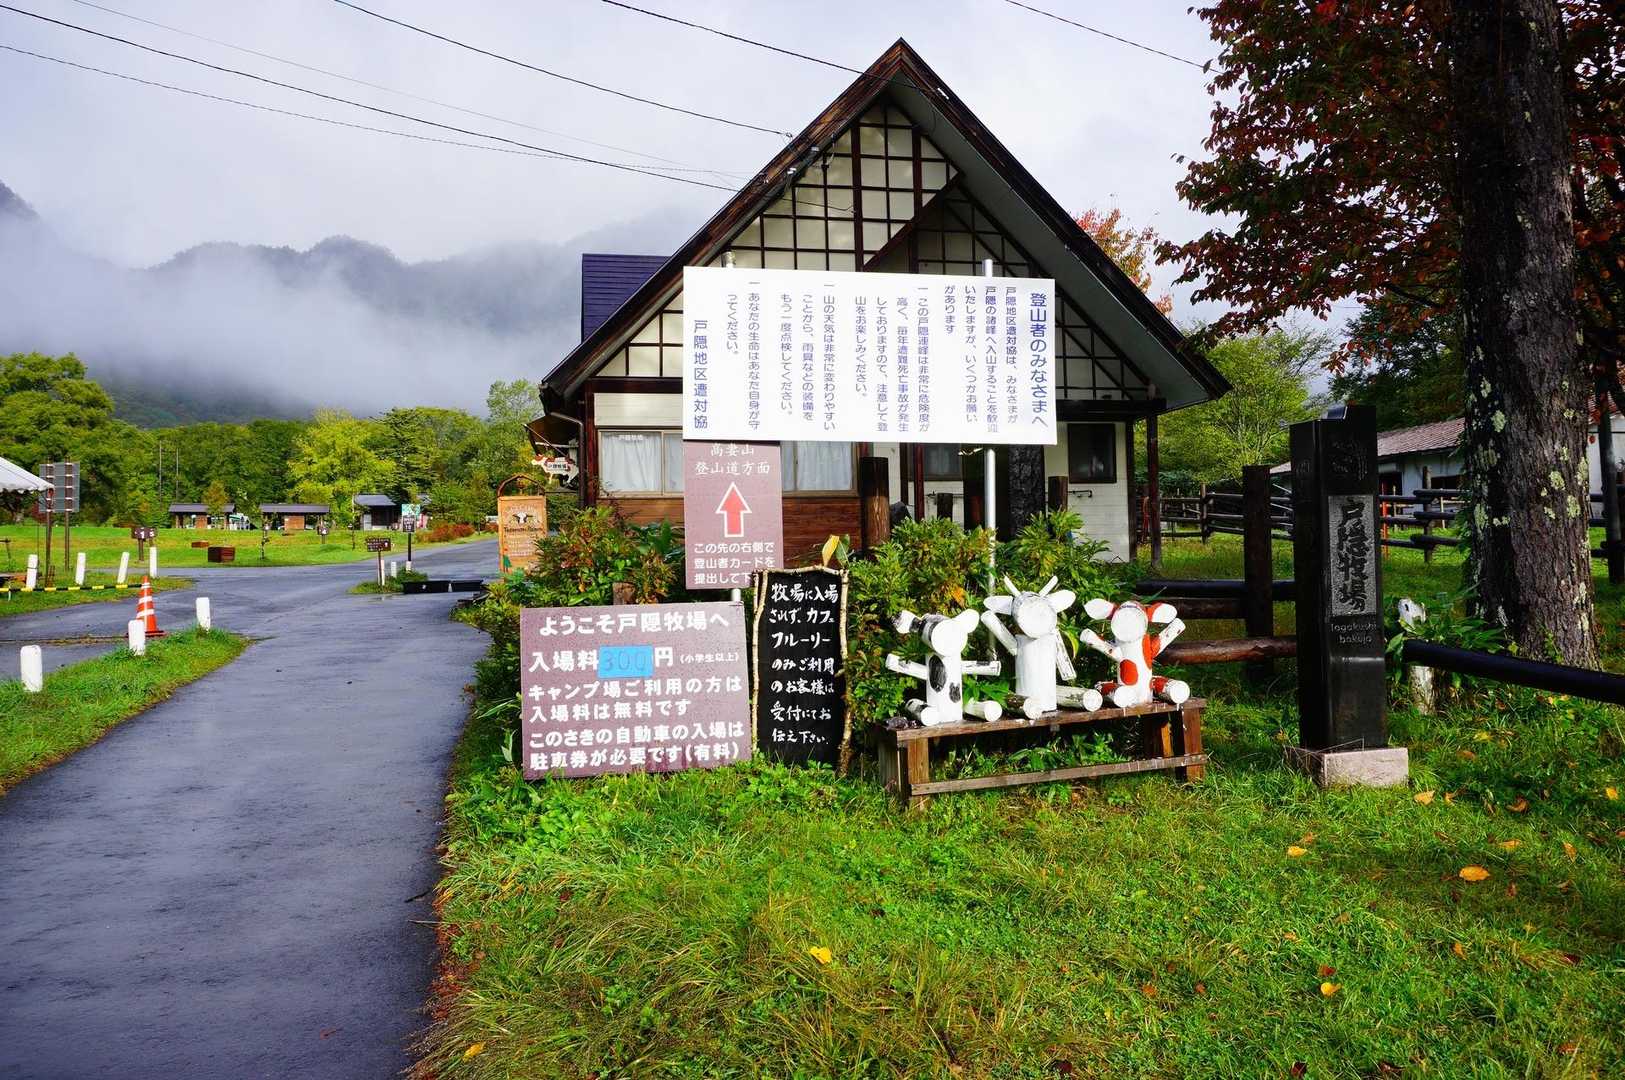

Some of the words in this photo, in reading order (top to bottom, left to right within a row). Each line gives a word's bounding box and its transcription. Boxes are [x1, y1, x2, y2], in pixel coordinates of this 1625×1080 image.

[944, 285, 956, 334] があります
[1030, 293, 1048, 428] 登山者のみなさまへ
[693, 319, 708, 429] 戸隠地区遭対協
[710, 443, 754, 457] 高妻山
[695, 461, 770, 476] 登山道方面
[694, 542, 775, 554] この先の右側で
[694, 557, 776, 570] 登山者カードを
[771, 583, 839, 603] 牧場に入場
[539, 611, 729, 636] ようこそ戸隠牧場へ
[771, 631, 831, 649] フルーリー
[771, 657, 834, 675] のみご利用
[528, 676, 742, 700] キャンプ場ご利用の方は
[770, 677, 834, 695] のお客様は
[529, 699, 691, 723] 入場料は無料です
[770, 700, 832, 722] 受付にてお
[529, 721, 745, 748] このさきの自動車の入場は
